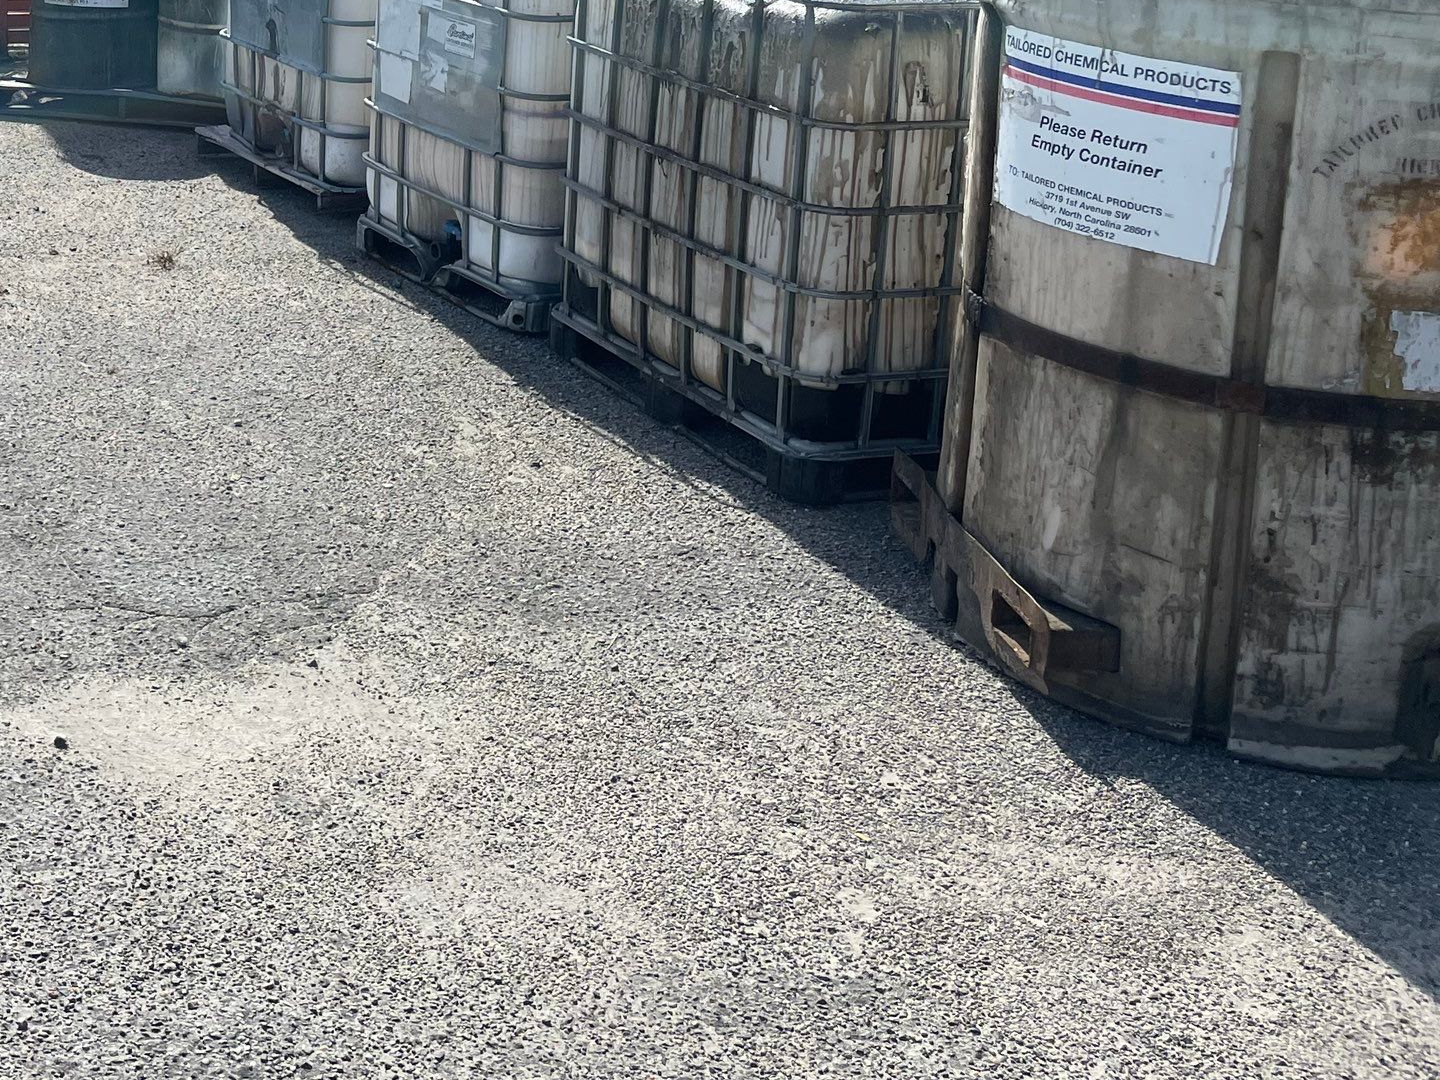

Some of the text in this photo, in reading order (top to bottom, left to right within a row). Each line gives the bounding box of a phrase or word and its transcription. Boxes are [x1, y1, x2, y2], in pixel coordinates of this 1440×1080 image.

[1006, 34, 1232, 95] TAILORED CHEMICAL PRODUCTS
[1039, 115, 1149, 155] Please Return
[1031, 133, 1164, 179] Empty Container
[1009, 164, 1163, 217] TO: TAILORED CHEMICAL PRODUCTS
[1045, 191, 1131, 221] 3719 1st Avenue SW
[1054, 217, 1115, 240] (704) 322-6512
[1059, 206, 1082, 220] North
[1084, 214, 1122, 230] Carolina
